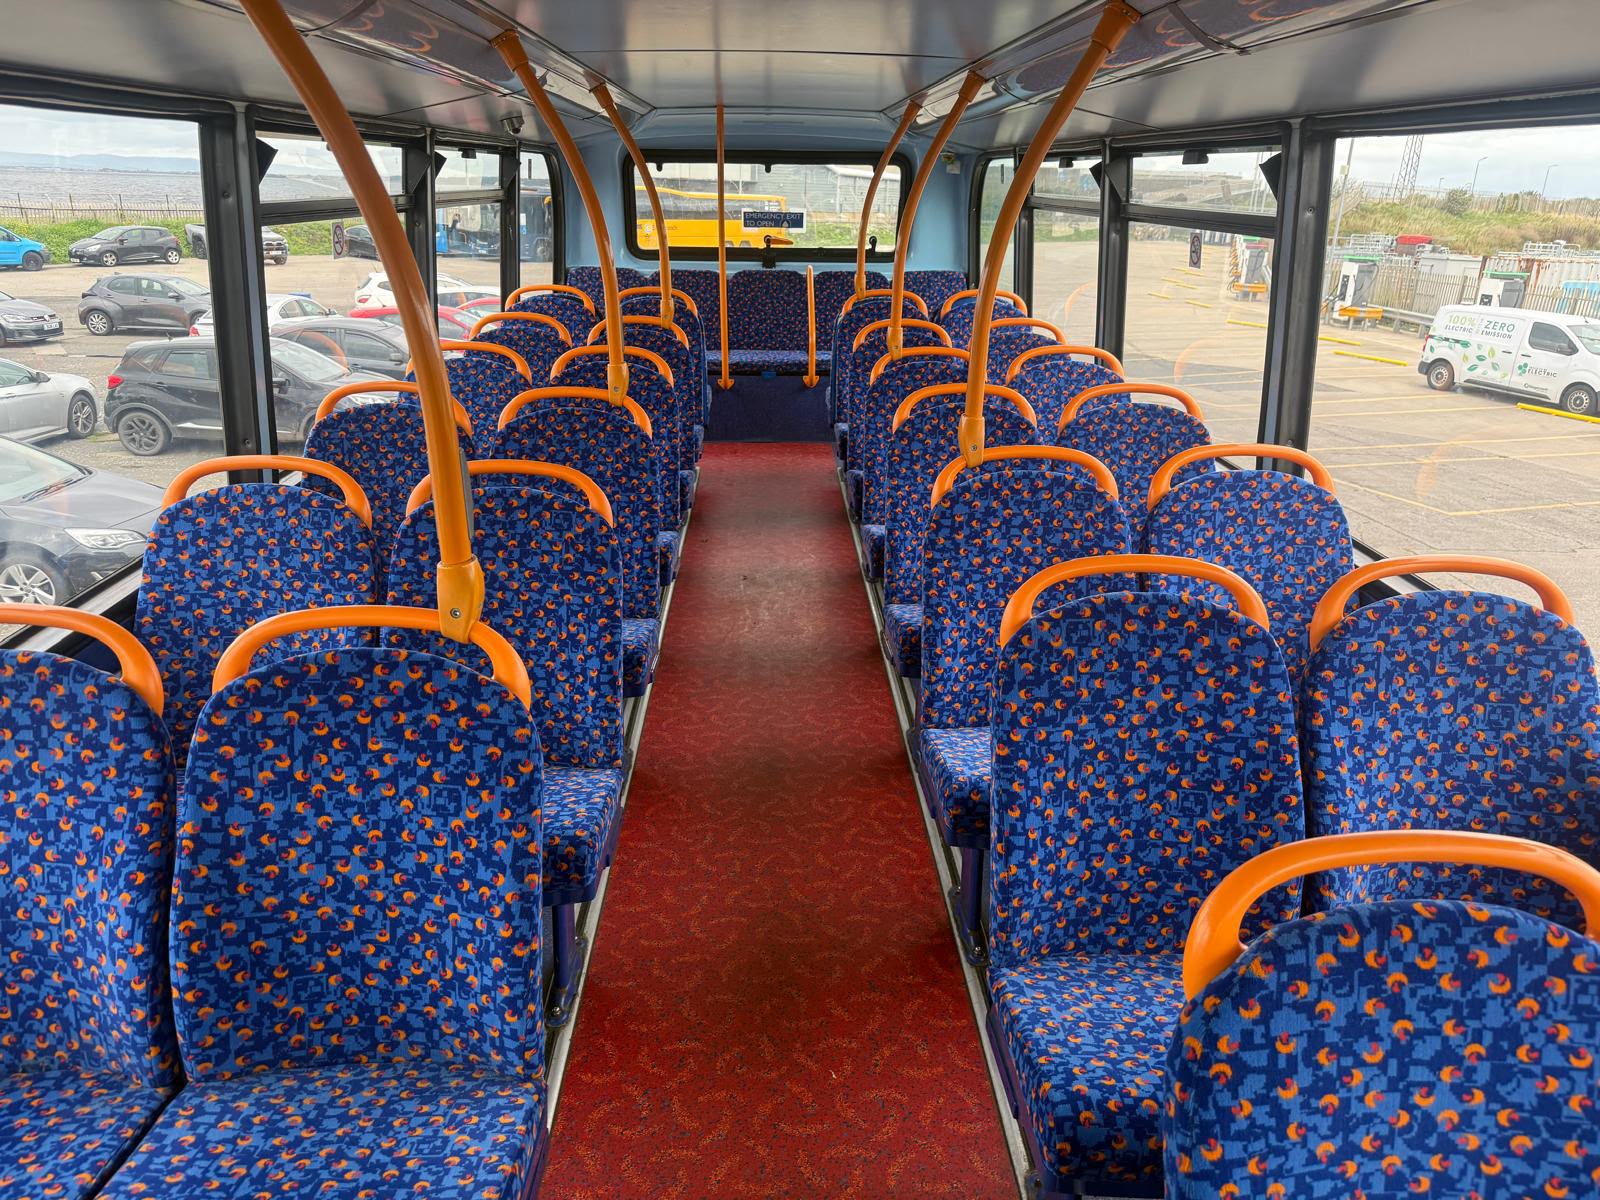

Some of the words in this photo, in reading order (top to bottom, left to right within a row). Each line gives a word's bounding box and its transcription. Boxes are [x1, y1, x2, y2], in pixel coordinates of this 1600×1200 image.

[1448, 314, 1477, 327] 100%
[1444, 324, 1474, 334] ELECTRIC
[1484, 320, 1515, 333] ZERO
[1480, 330, 1513, 340] EMISSION
[1527, 368, 1558, 378] ELECTRIC
